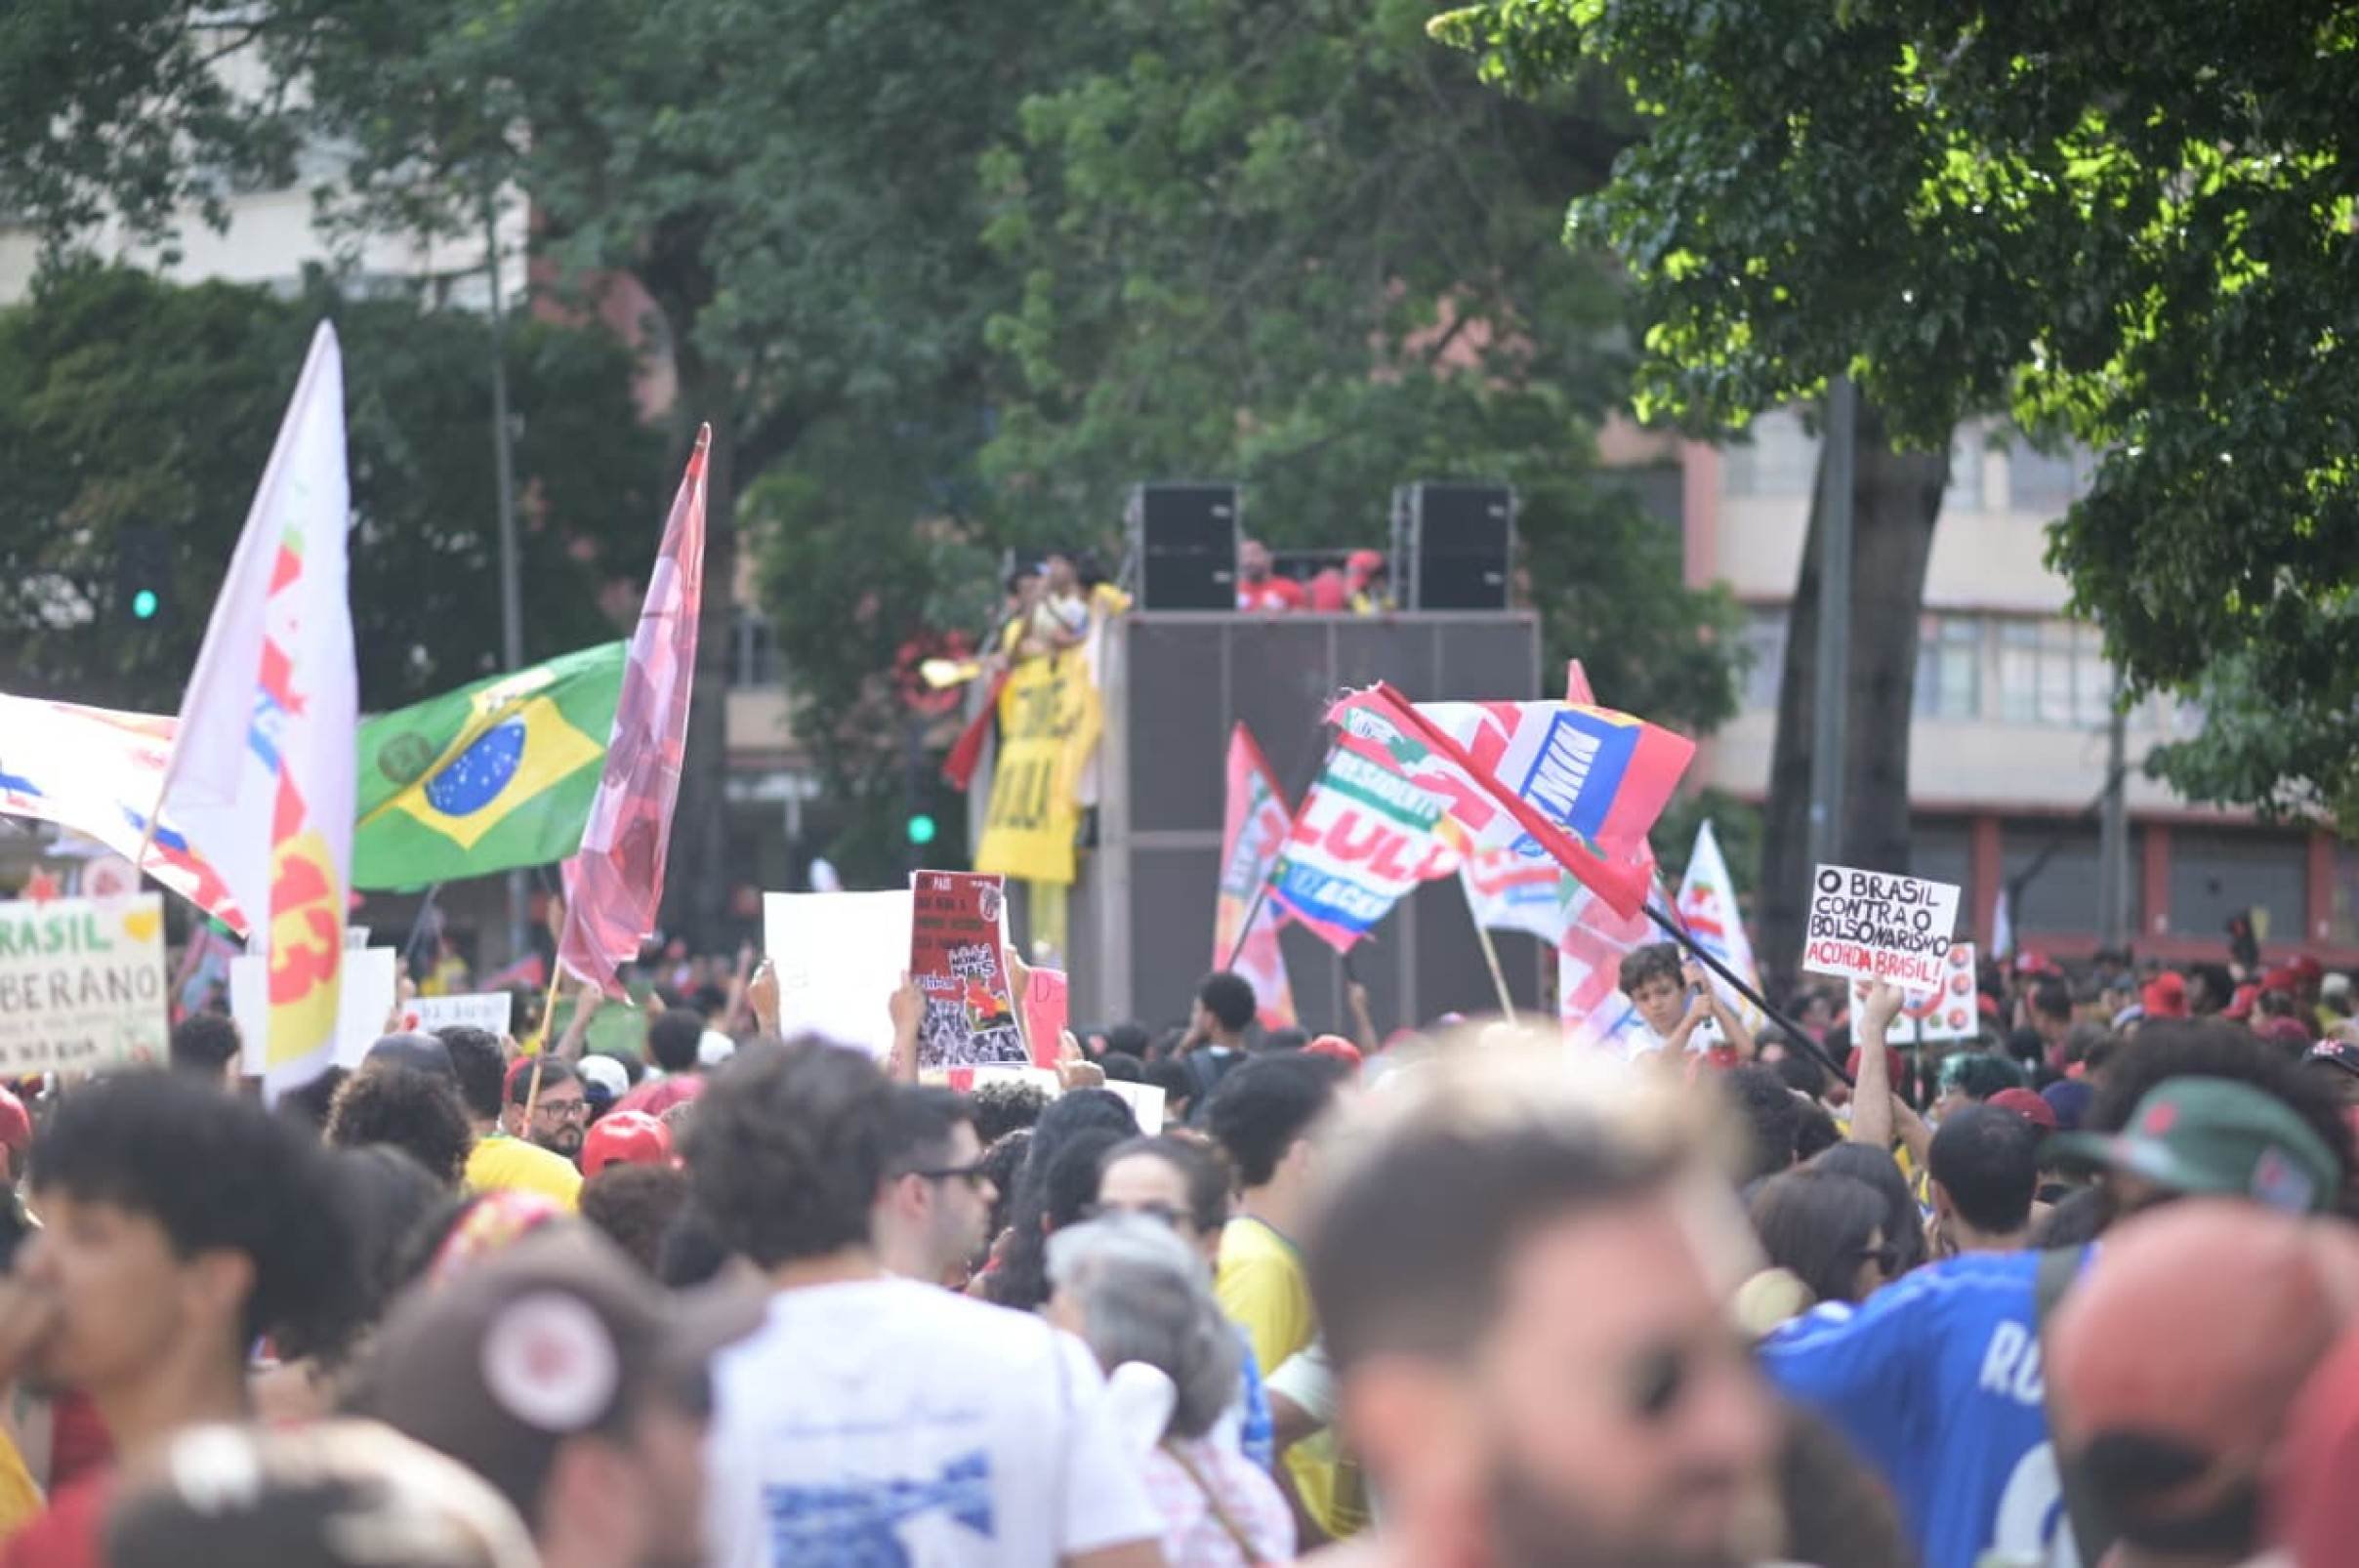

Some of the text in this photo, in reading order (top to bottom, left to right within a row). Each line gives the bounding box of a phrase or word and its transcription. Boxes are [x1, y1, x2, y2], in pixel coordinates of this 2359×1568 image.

[1325, 747, 1457, 822] RESIDENTE
[1524, 721, 1602, 823] KMIN
[1818, 869, 1842, 894] O
[1815, 896, 1932, 932] CONTRA O
[1811, 915, 1949, 957] BOLSONARISMO
[1808, 940, 1873, 972] ACORDA
